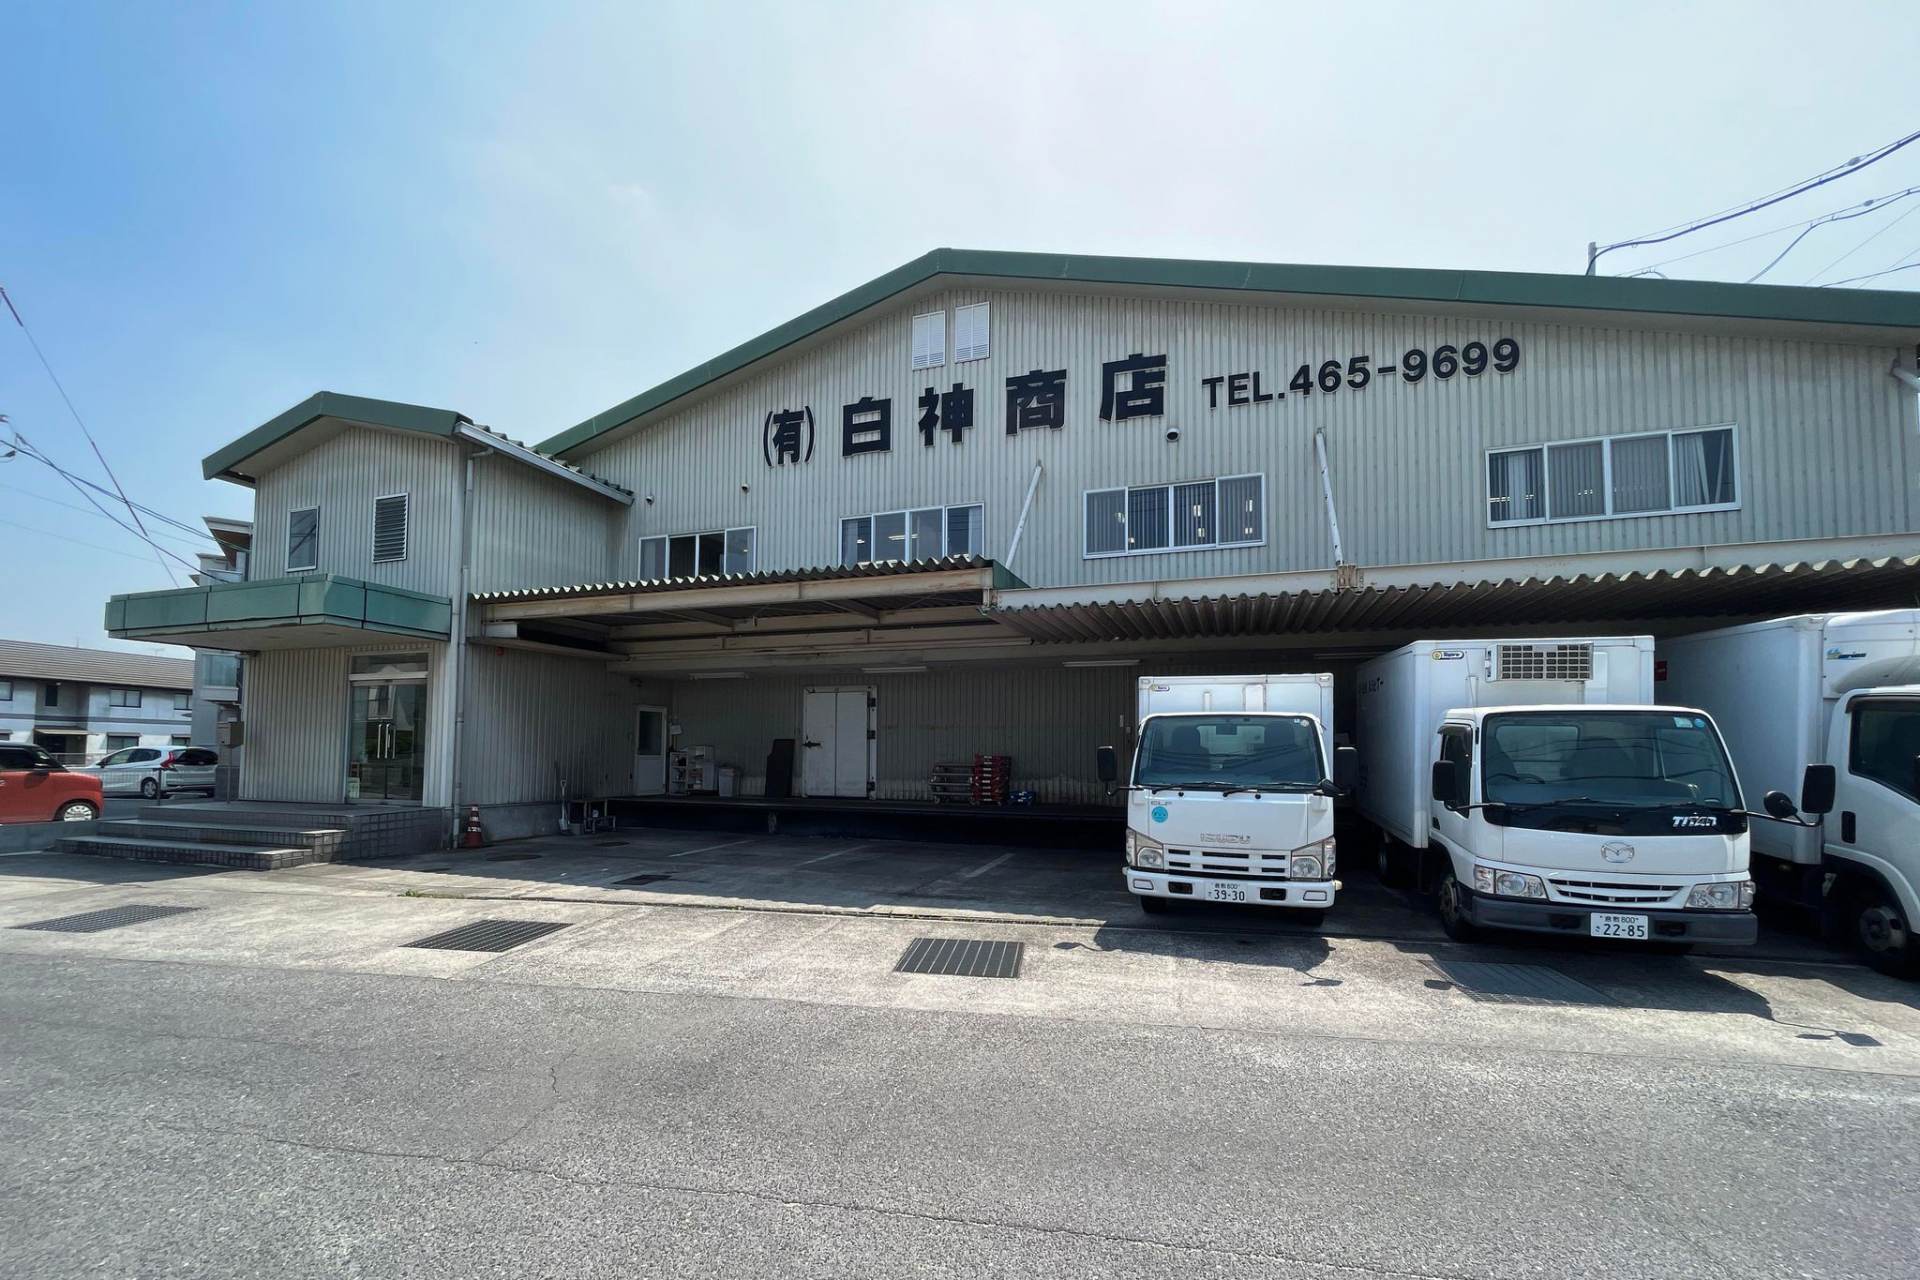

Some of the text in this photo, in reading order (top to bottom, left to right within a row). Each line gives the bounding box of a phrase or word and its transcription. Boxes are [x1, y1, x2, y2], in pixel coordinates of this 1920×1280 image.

[1202, 338, 1521, 408] TEL.465-9699
[1672, 815, 1717, 827] TITAN
[1200, 833, 1250, 845] ISUZU
[1214, 889, 1245, 901] 39-30
[1603, 923, 1645, 938] 22-85
